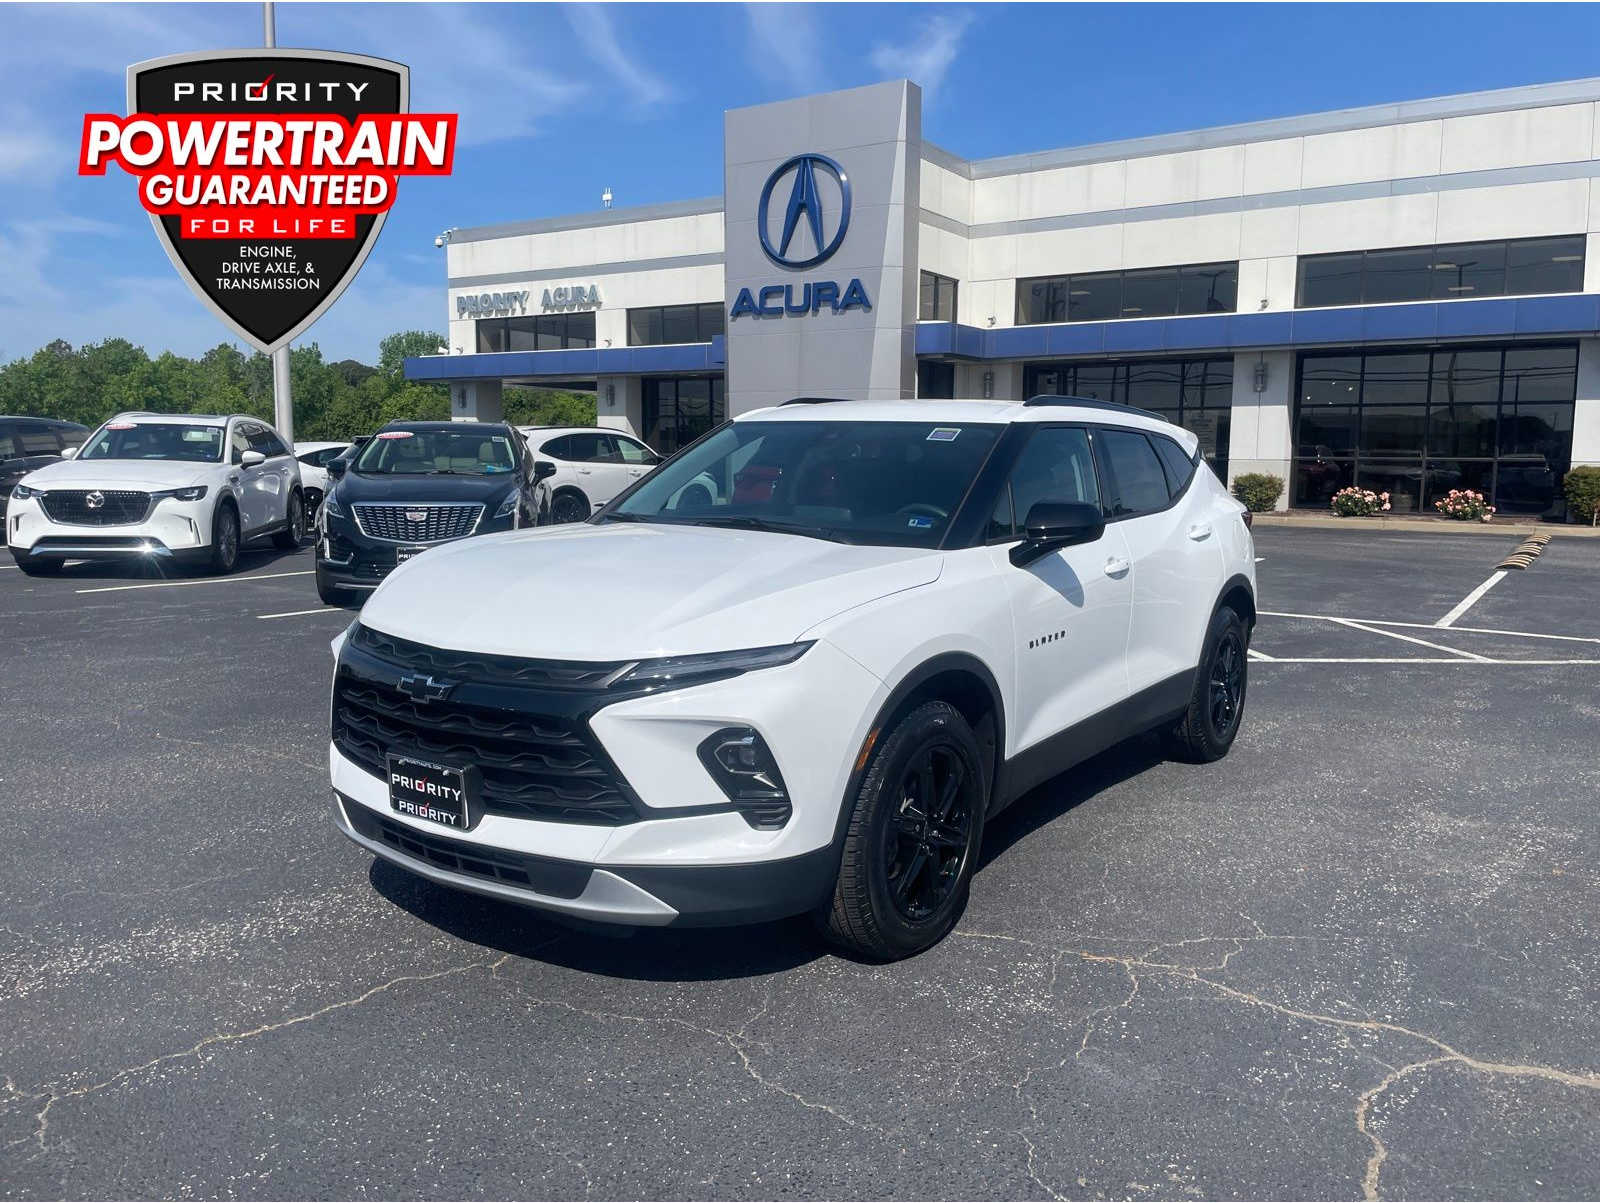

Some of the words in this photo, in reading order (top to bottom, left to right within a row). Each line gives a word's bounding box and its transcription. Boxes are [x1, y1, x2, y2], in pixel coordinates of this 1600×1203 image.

[456, 290, 529, 316] PRIORITY
[541, 284, 602, 311] ACURA
[731, 278, 872, 321] ACURA
[1029, 630, 1065, 649] BLAZER
[391, 773, 461, 801] PRIORITY
[399, 801, 456, 825] PRIORITY
